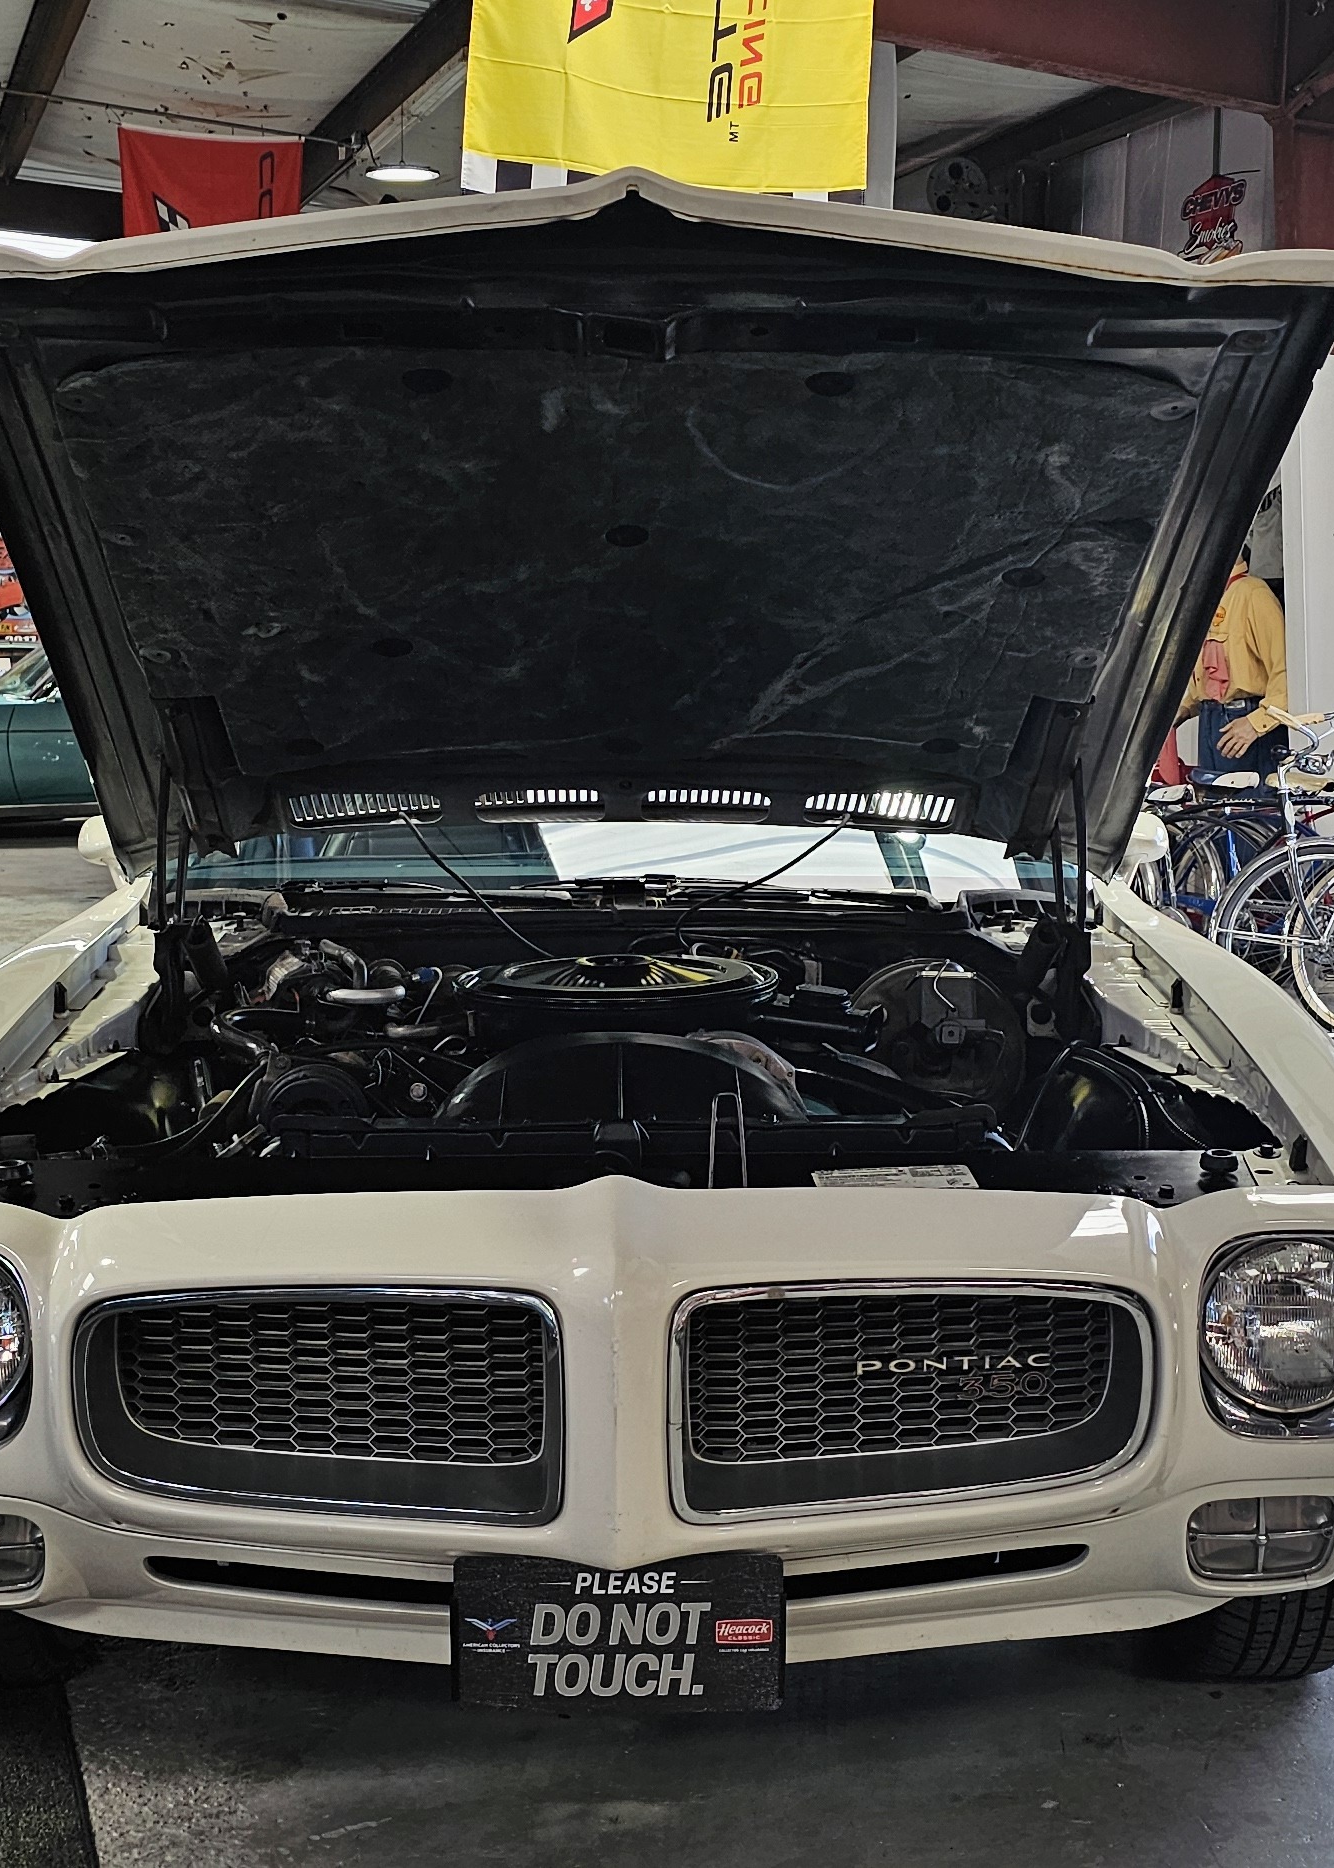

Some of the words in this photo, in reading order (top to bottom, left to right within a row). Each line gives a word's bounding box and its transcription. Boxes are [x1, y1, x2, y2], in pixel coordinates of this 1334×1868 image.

[1181, 179, 1246, 220] CHEVYS
[857, 1353, 1051, 1376] PONTIAC
[957, 1371, 1048, 1400] 350
[574, 1571, 677, 1595] PLEASE
[529, 1602, 601, 1646] DO
[609, 1602, 711, 1645] NOT
[718, 1622, 770, 1636] Heacock
[528, 1653, 704, 1697] TOUCH.
